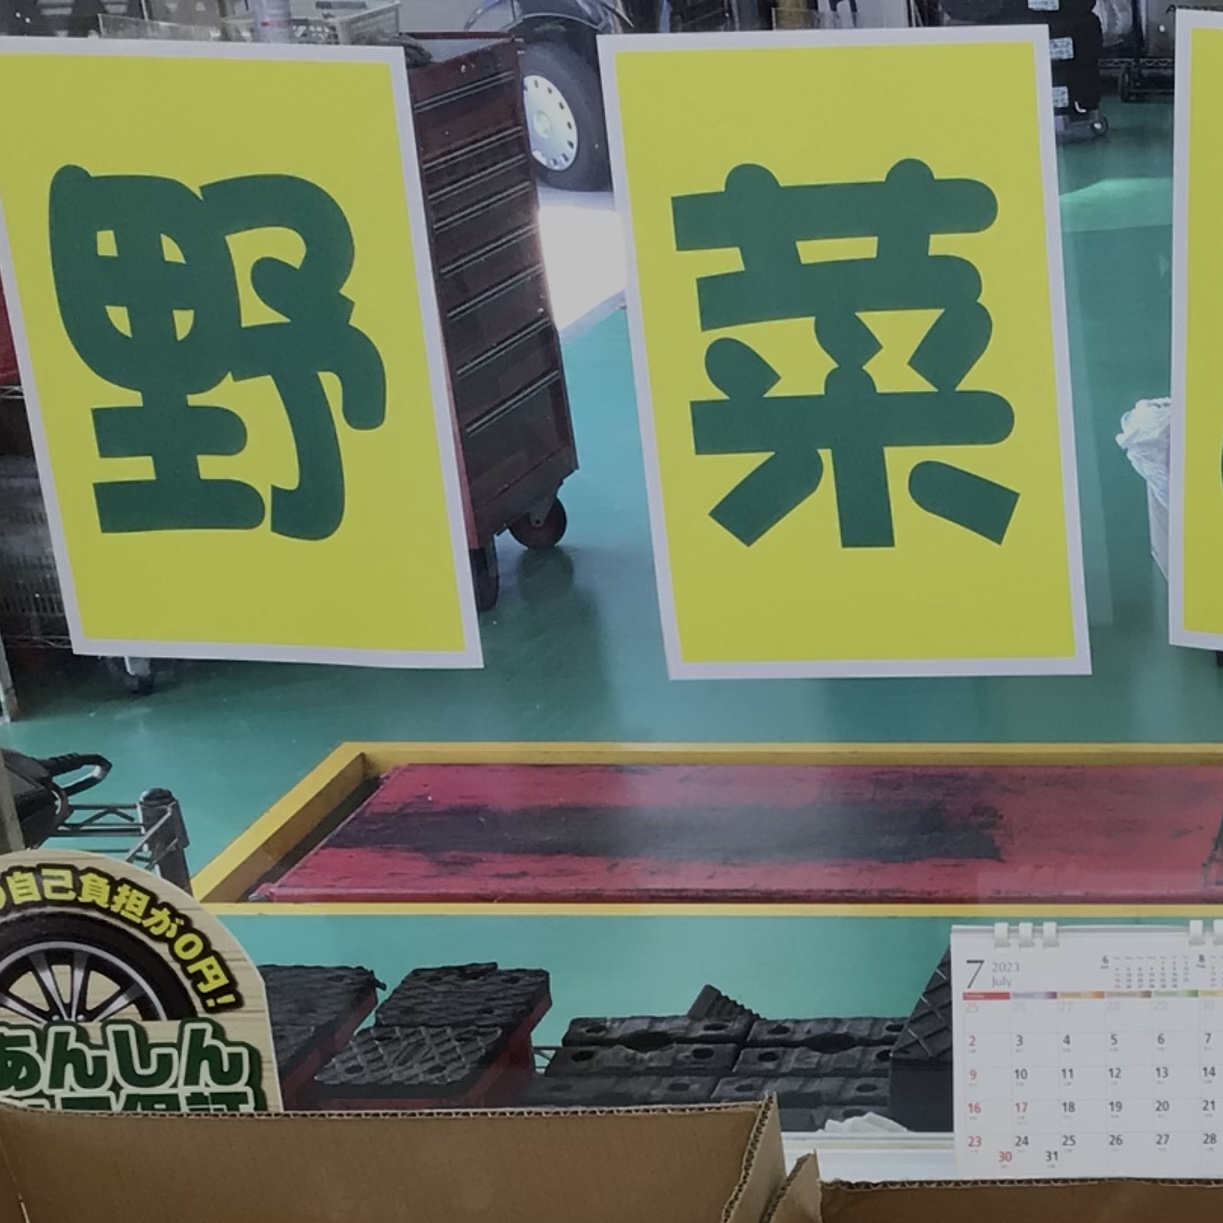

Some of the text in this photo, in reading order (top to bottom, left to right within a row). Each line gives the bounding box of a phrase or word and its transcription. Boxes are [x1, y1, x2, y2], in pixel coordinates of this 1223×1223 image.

[0, 867, 236, 1008] 自己負担が0円!
[966, 960, 985, 989] 7
[992, 962, 1020, 973] 2023
[992, 975, 1013, 989] July
[969, 1036, 976, 1047] 2
[1016, 1035, 1024, 1046] 3
[1063, 1034, 1071, 1045] 4
[1110, 1034, 1118, 1045] 5
[1157, 1034, 1165, 1045] 6
[1204, 1033, 1212, 1044] 7
[0, 1019, 248, 1093] あんしん
[969, 1069, 977, 1080] 9
[1014, 1069, 1028, 1080] 10
[1062, 1068, 1074, 1079] 11
[1109, 1068, 1122, 1079] 12
[1156, 1067, 1169, 1078] 13
[1202, 1066, 1216, 1078] 14
[968, 1102, 981, 1114] 16
[1015, 1102, 1028, 1113] 17
[1062, 1102, 1075, 1113] 18
[1109, 1101, 1122, 1112] 19
[1156, 1100, 1169, 1112] 20
[1202, 1100, 1215, 1111] 21
[968, 1135, 982, 1147] 23
[1015, 1135, 1029, 1147] 24
[1062, 1135, 1076, 1146] 25
[1109, 1134, 1123, 1146] 26
[1156, 1133, 1170, 1145] 27
[1203, 1133, 1217, 1144] 28
[998, 1150, 1058, 1162] 30 31
